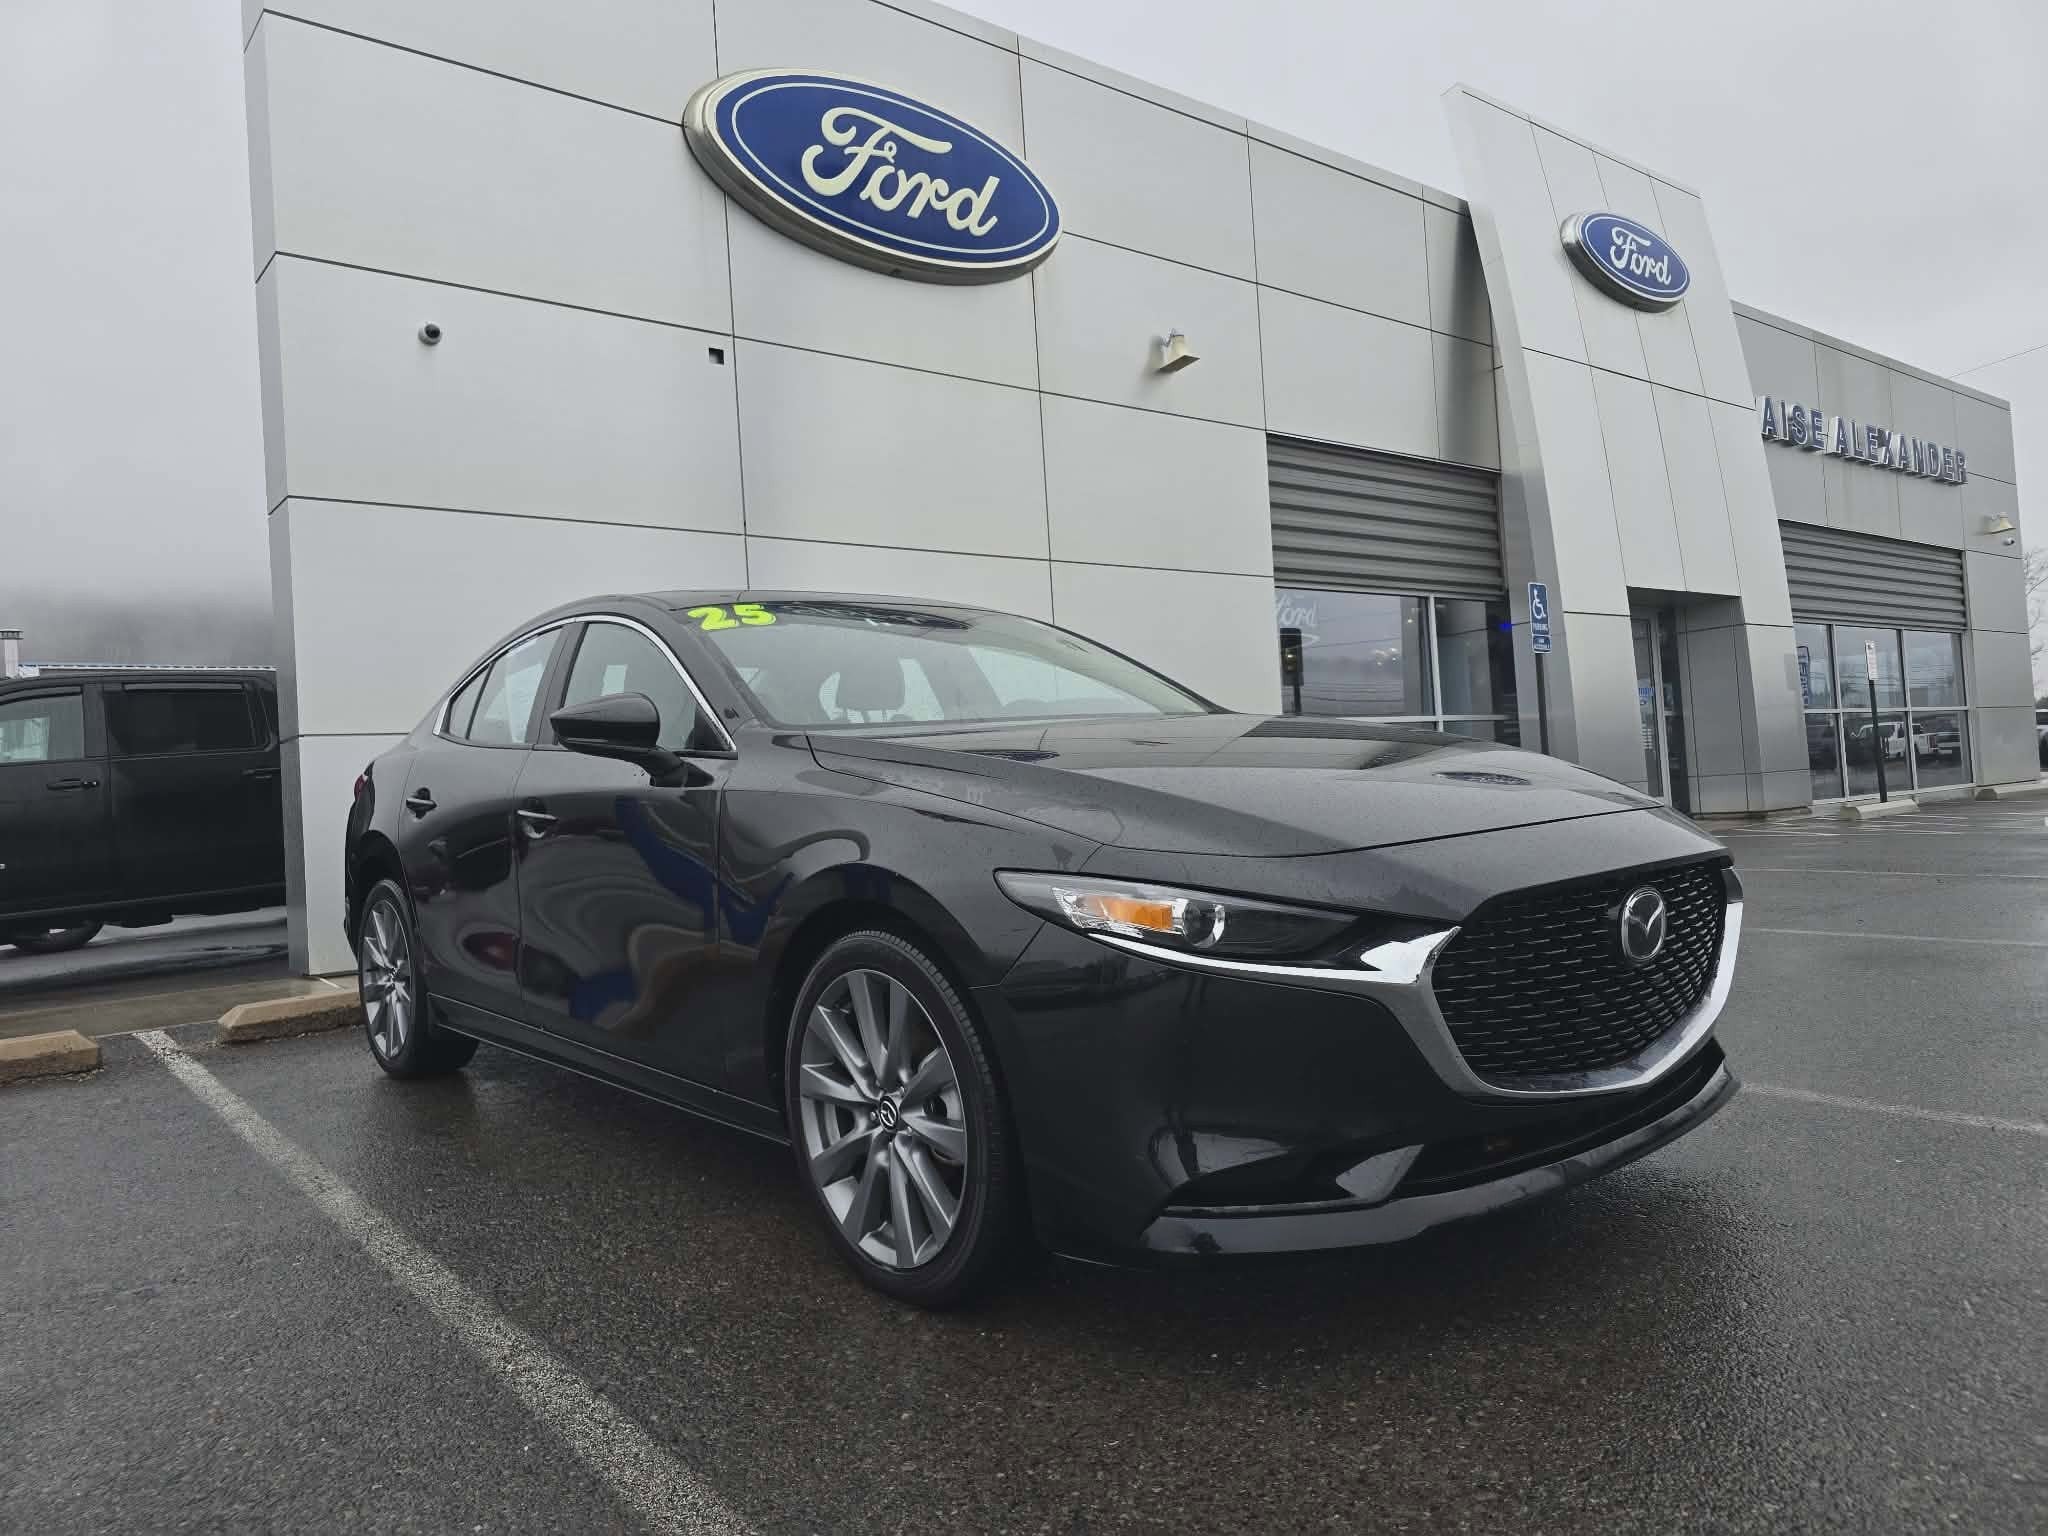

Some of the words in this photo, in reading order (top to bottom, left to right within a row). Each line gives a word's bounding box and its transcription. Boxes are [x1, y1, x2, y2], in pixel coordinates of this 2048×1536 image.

[801, 106, 1000, 236] Ford
[1610, 227, 1671, 285] Ford
[1829, 415, 1968, 484] ALEXANDER
[687, 604, 776, 630] 25
